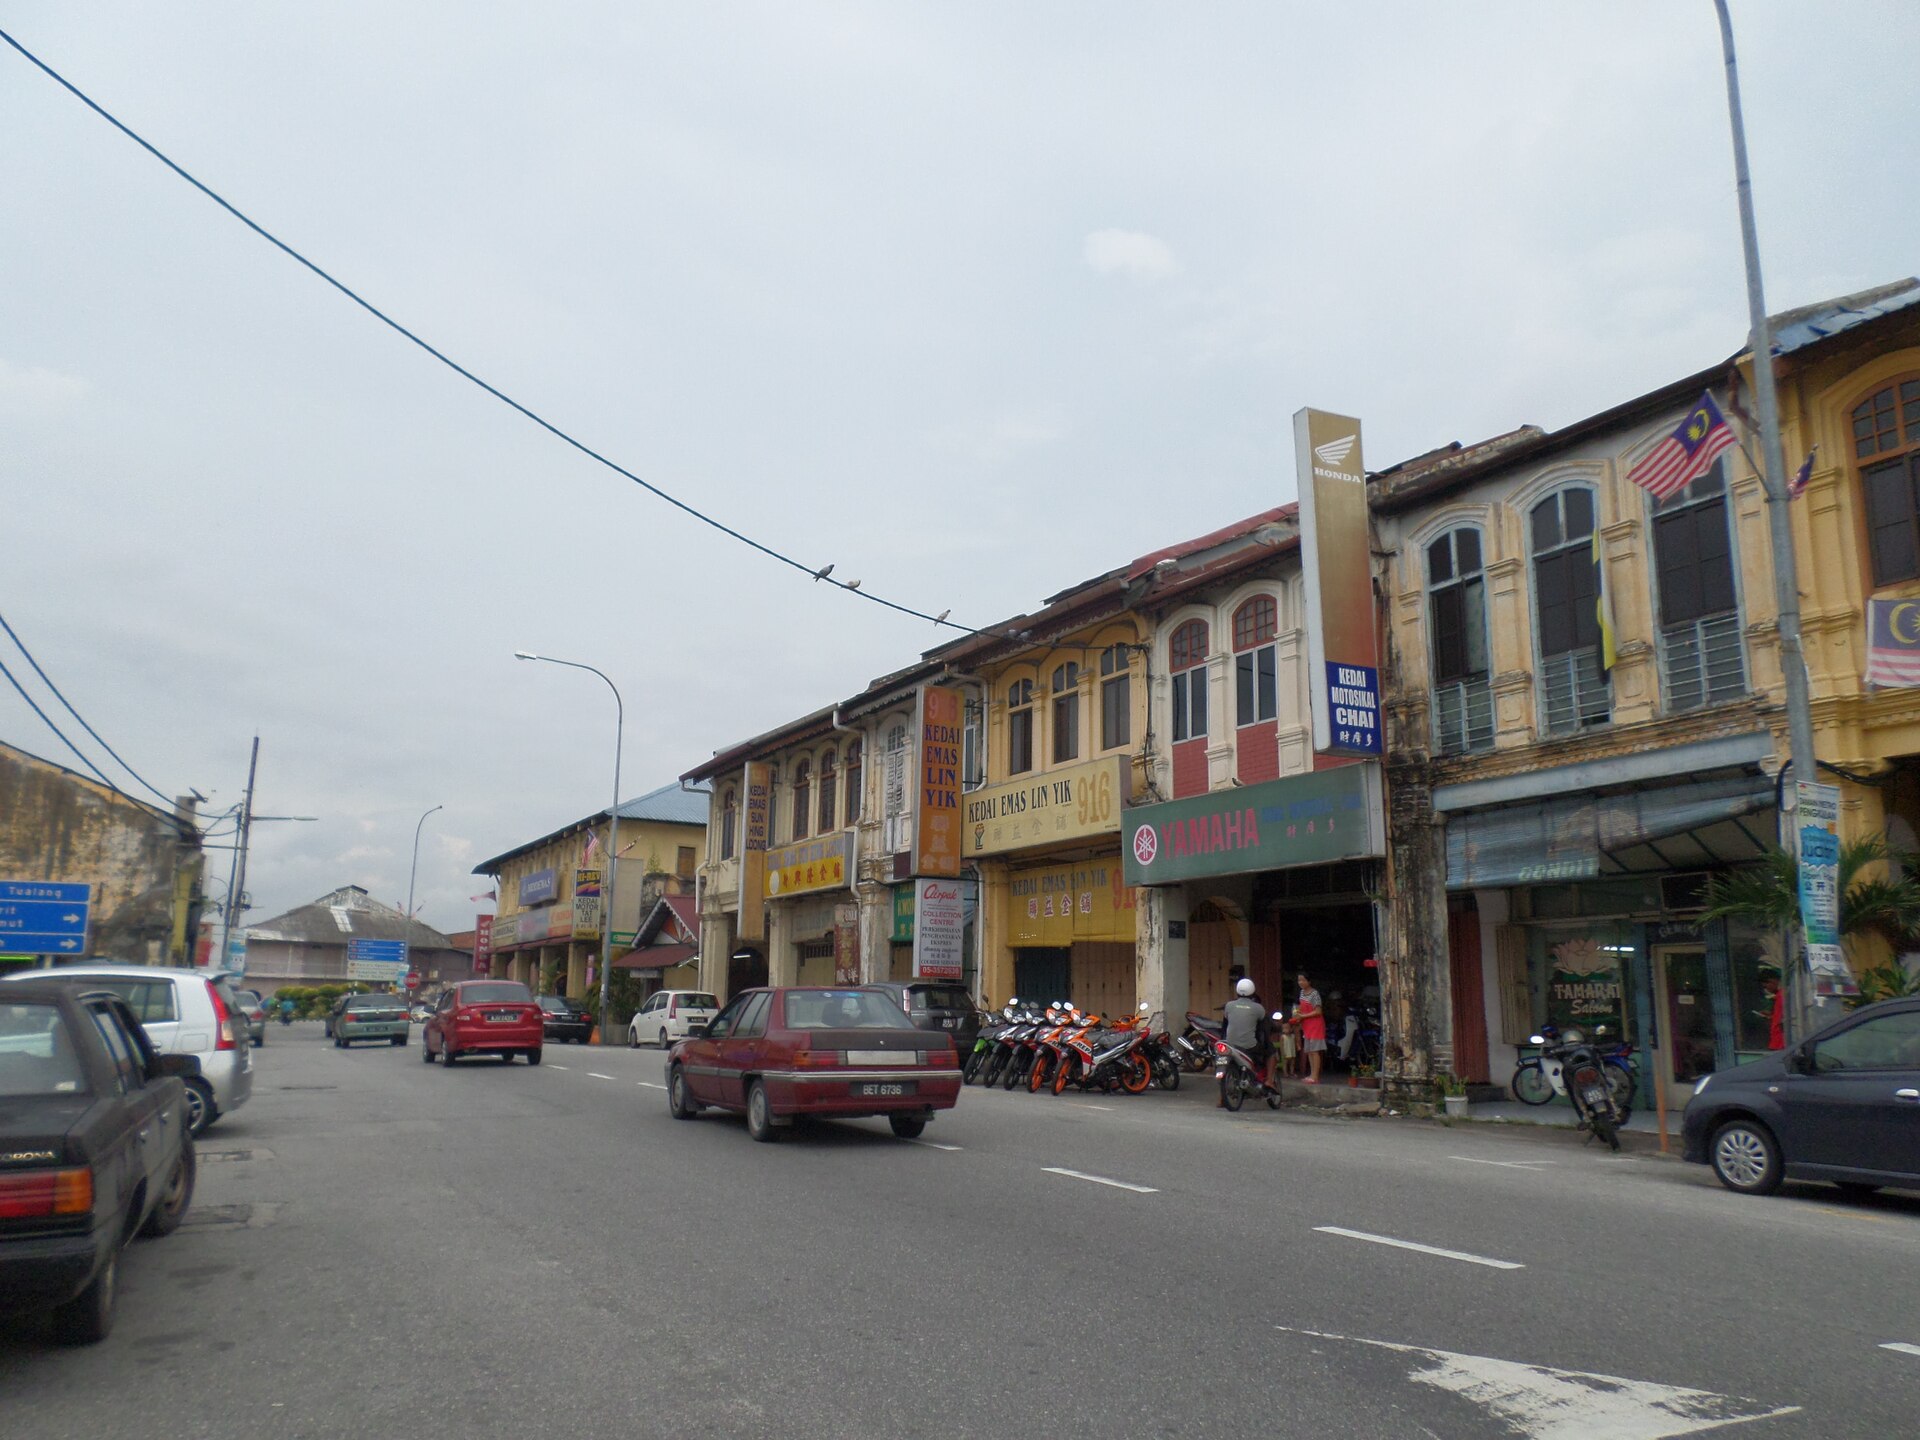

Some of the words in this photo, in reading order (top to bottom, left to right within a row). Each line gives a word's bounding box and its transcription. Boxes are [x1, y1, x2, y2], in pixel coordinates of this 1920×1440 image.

[1313, 466, 1361, 483] HONDA
[1338, 667, 1366, 687] KEDAI
[1331, 686, 1376, 708] MOTOSIKAL
[1335, 707, 1374, 728] CHAI
[925, 724, 960, 744] KEDAI
[926, 746, 958, 766] EMAS
[927, 767, 956, 786] LIN
[749, 785, 768, 796] KEDAI
[925, 789, 956, 808] YIK
[969, 797, 996, 823] KEDAI
[1001, 789, 1026, 816] EMAS
[1031, 784, 1048, 809] LIN
[1053, 779, 1072, 805] YIK
[1077, 770, 1111, 826] 916
[748, 798, 766, 809] EMAS
[751, 812, 764, 823] SUN
[749, 825, 764, 837] HING
[1160, 807, 1260, 861] YAMAHA
[746, 839, 767, 851] LOONG
[1012, 877, 1038, 897] KEDAI
[1041, 873, 1066, 893] EMAS
[1091, 867, 1108, 887] YIK
[8, 886, 62, 899] Tualang
[922, 910, 962, 919] COLLECTION
[929, 918, 955, 926] CENTRE
[1570, 999, 1613, 1015] Saloon
[863, 1084, 879, 1095] BET
[880, 1084, 902, 1095] 6736
[0, 1151, 55, 1161] ORONA
